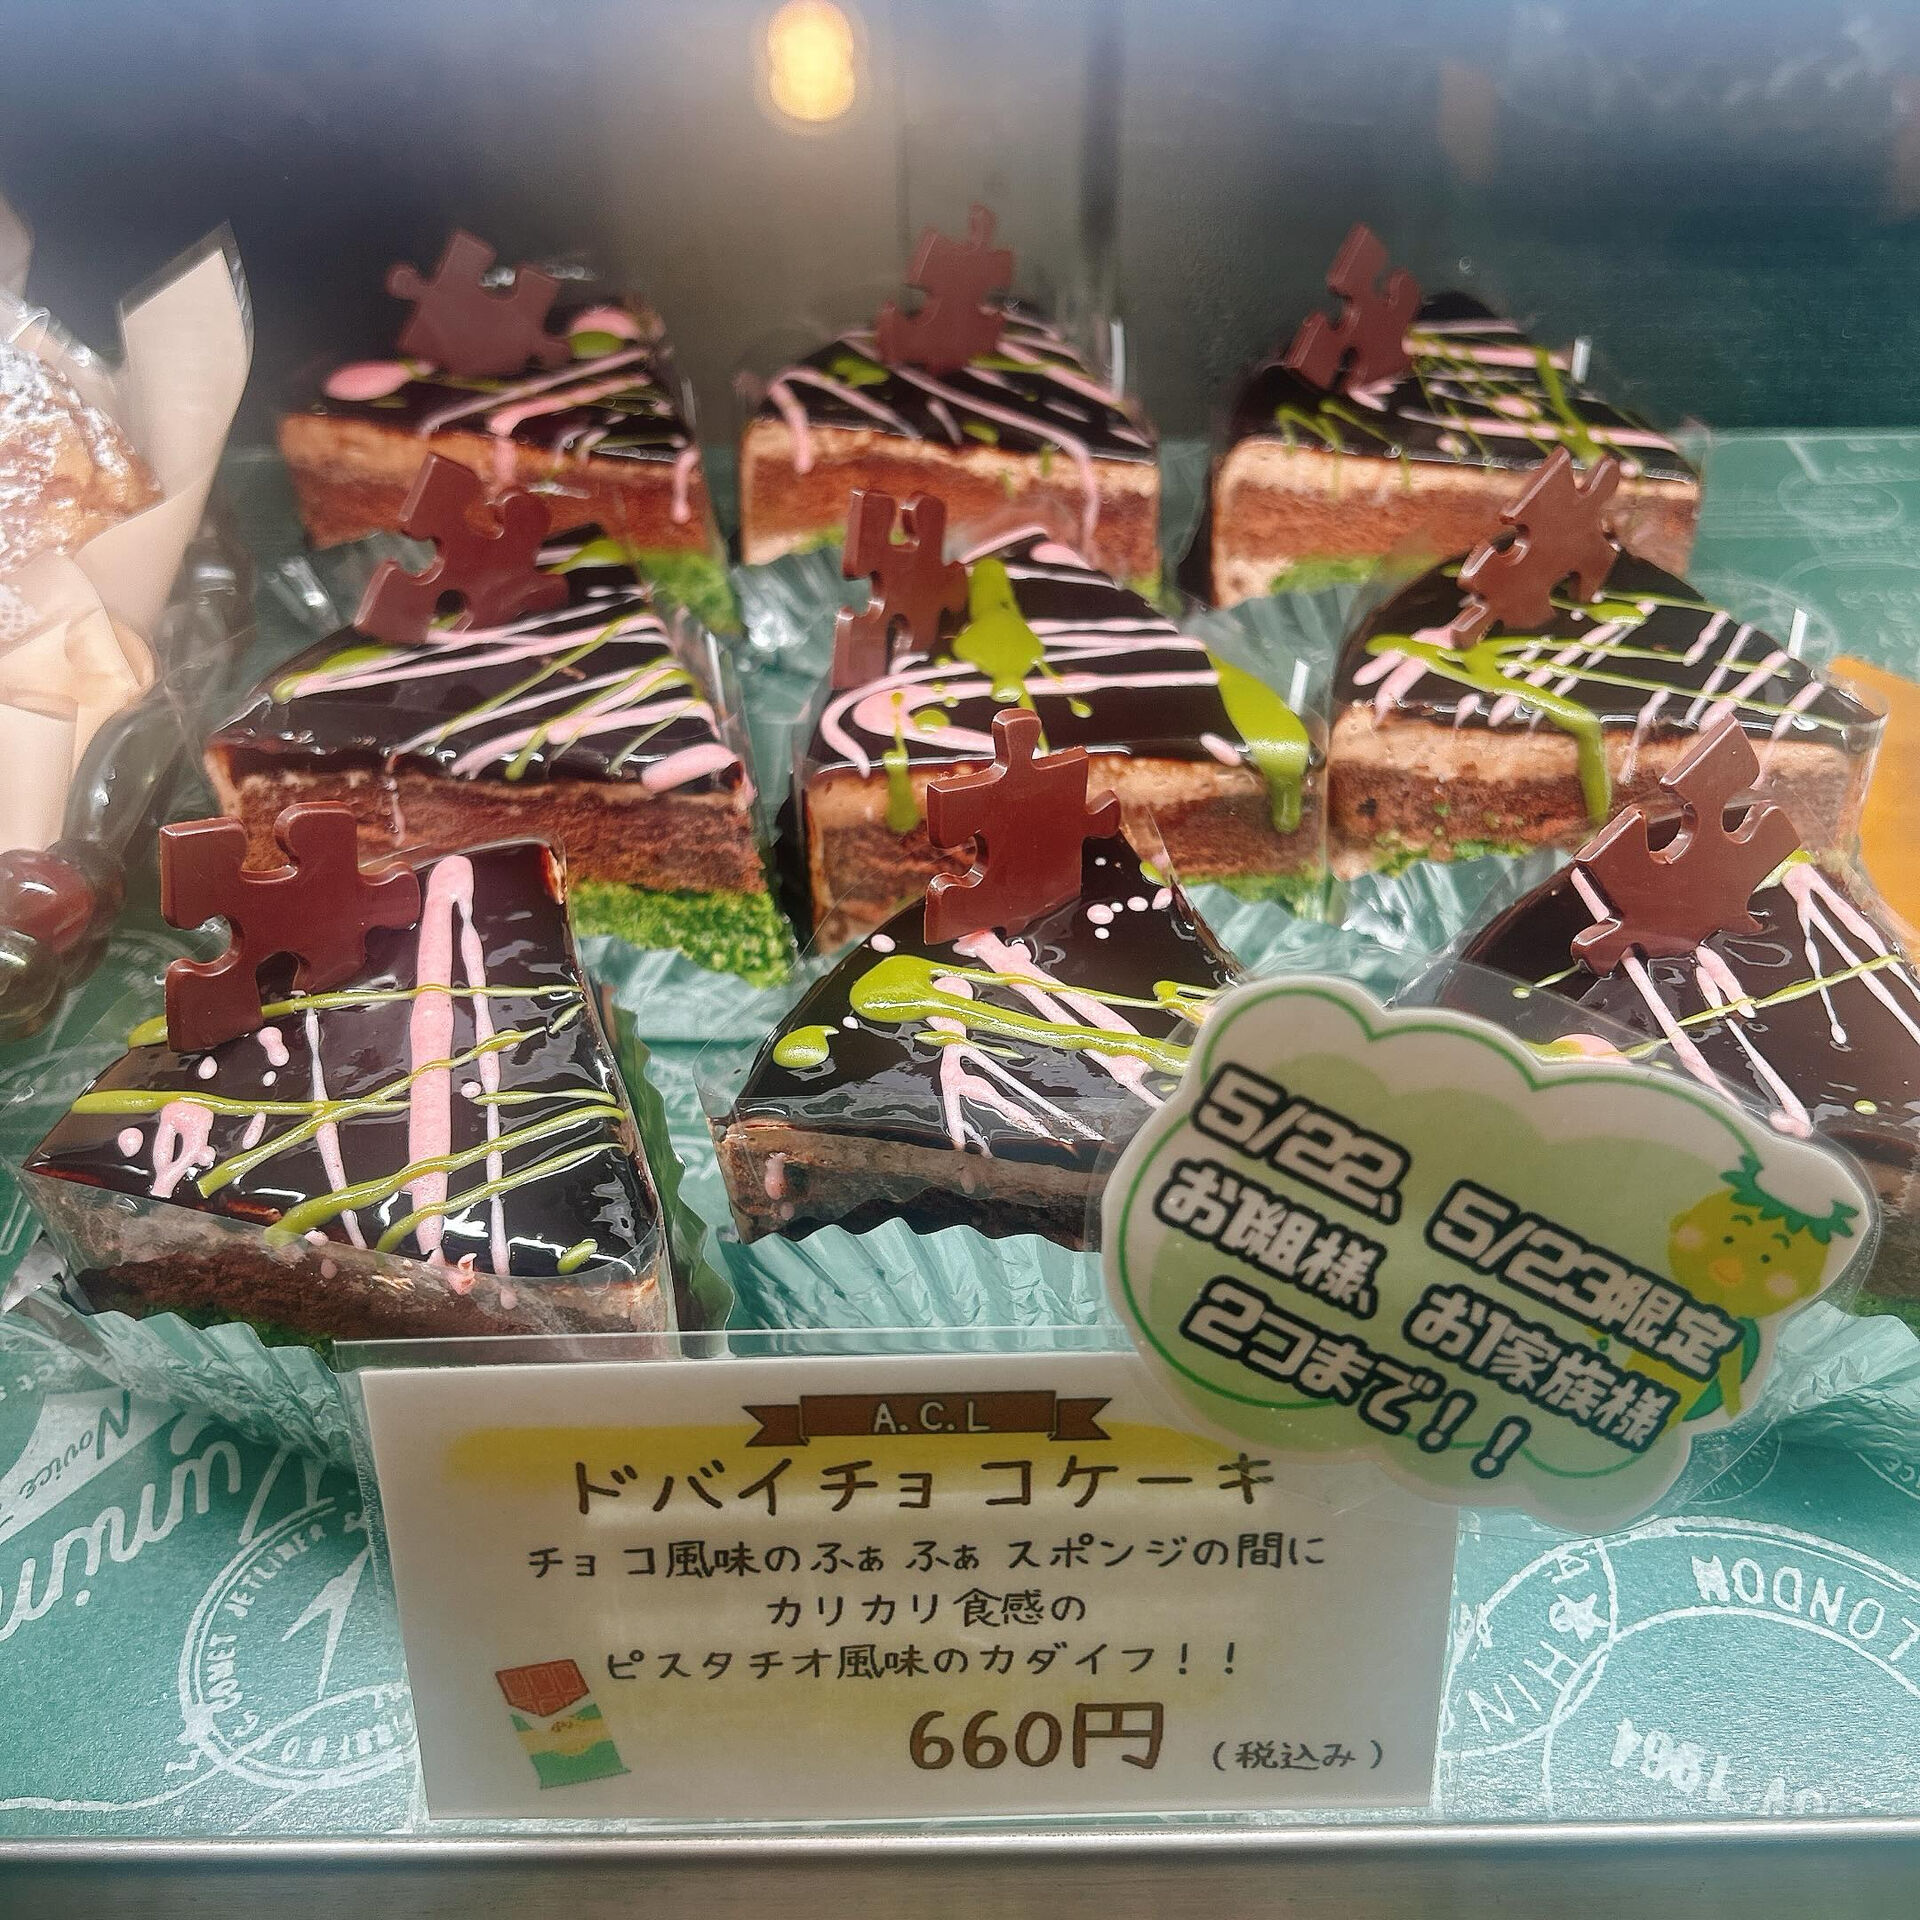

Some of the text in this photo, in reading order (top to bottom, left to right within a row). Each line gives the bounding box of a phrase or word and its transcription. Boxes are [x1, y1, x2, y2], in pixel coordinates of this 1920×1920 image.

[873, 1400, 990, 1432] A.C.L
[575, 1455, 1275, 1516] ドバイチョコケーキ
[766, 1587, 1086, 1629] カリカリ食感の
[607, 1641, 1237, 1681] ピスタチオ風味のカダイフ！！
[909, 1701, 1165, 1770] 660円
